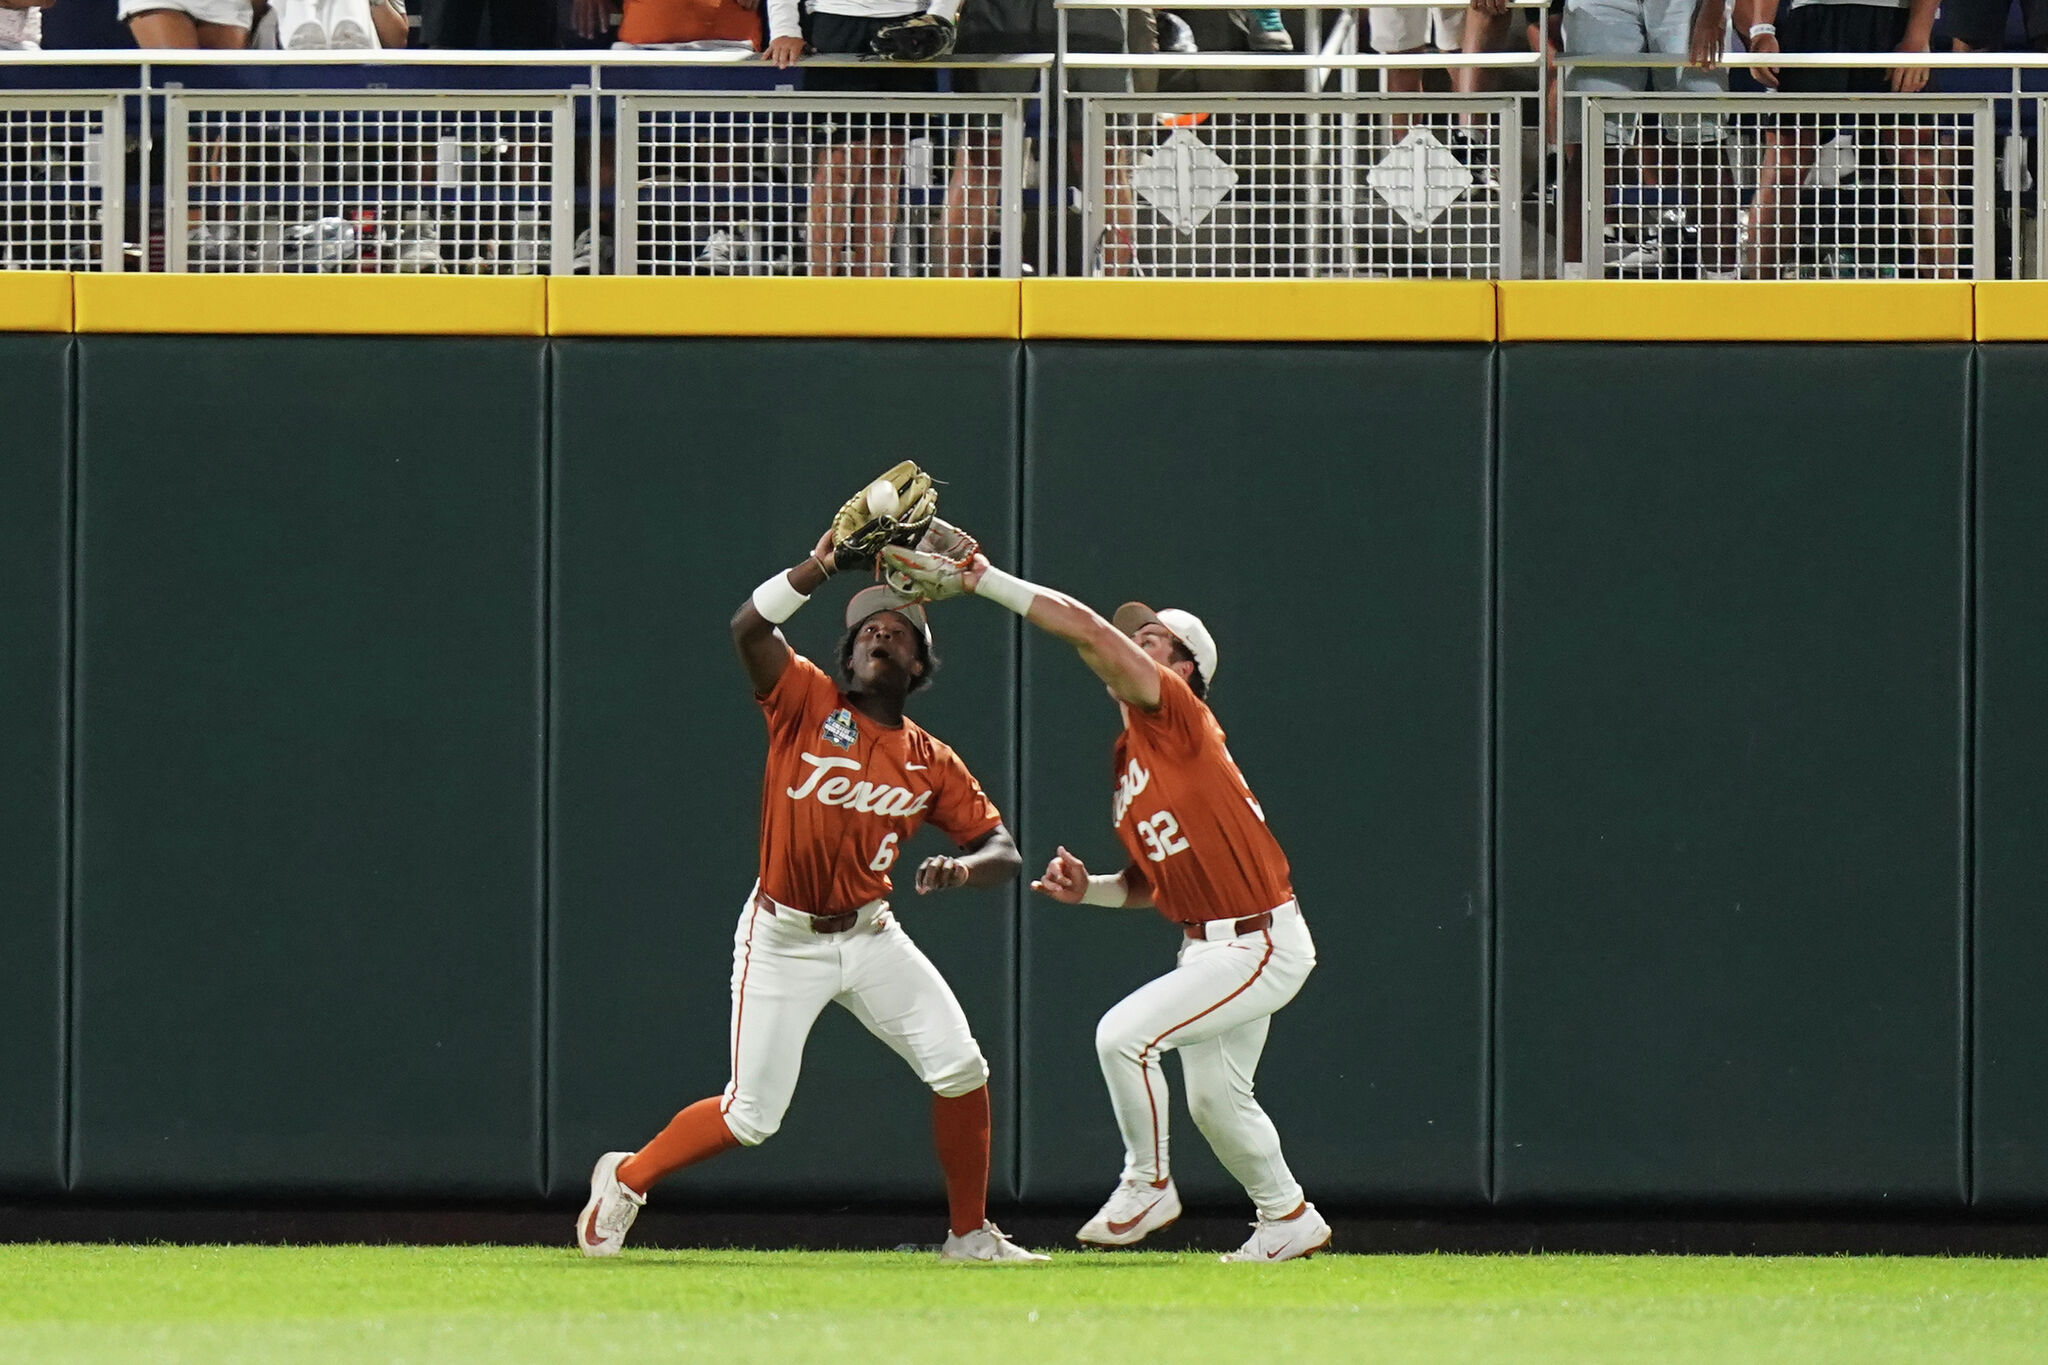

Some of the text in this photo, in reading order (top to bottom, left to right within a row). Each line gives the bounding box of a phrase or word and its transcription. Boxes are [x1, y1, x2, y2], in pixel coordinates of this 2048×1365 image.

[787, 752, 932, 816] Texas
[870, 832, 898, 871] 6
[1137, 811, 1190, 862] 32
